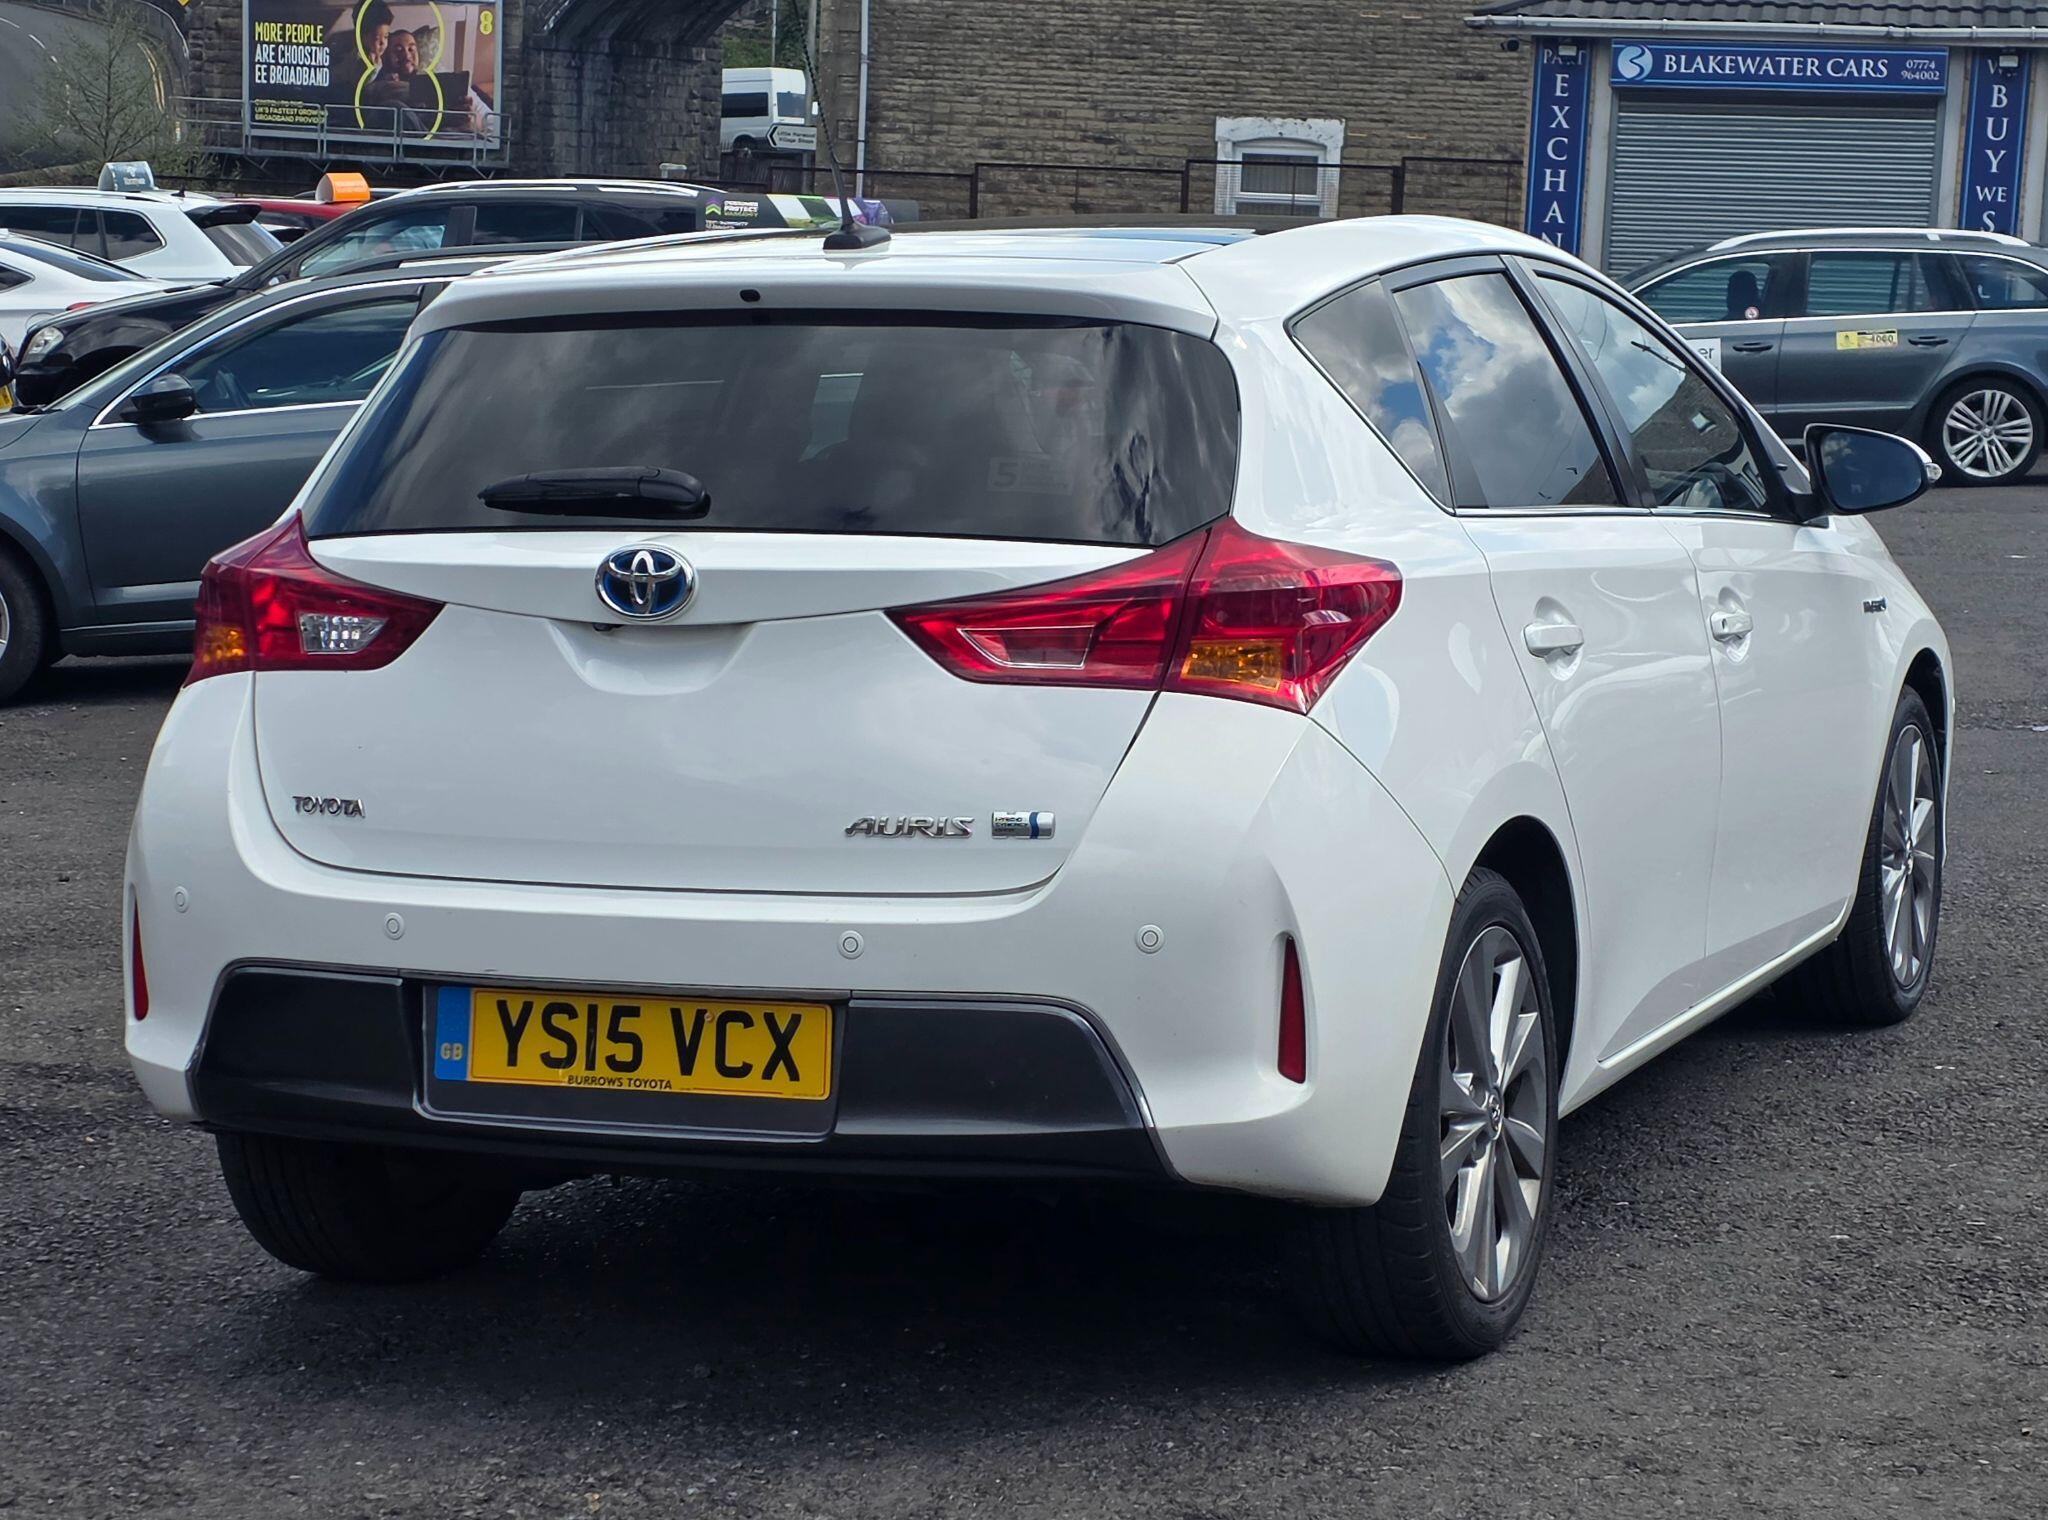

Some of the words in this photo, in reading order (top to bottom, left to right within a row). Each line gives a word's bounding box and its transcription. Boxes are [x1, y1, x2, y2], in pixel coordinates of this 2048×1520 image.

[255, 22, 283, 42] MORE
[285, 24, 323, 44] PEOPLE
[255, 44, 276, 63] ARE
[278, 45, 330, 66] CHOOSING
[1664, 54, 1822, 76] BLAKEWATER
[1826, 58, 1888, 78] CARS
[1905, 59, 1936, 69] 07774
[255, 64, 268, 84] EE
[269, 65, 330, 87] BROADBAND
[1900, 70, 1940, 80] 964002
[1985, 85, 2010, 173] BUY
[1976, 186, 2008, 202] WE
[292, 796, 365, 819] TOYOTA
[844, 815, 976, 838] AURIS
[439, 1041, 464, 1061] GB
[496, 1000, 643, 1073] YS15
[671, 1007, 803, 1082] VCX
[567, 1075, 623, 1089] BURROWS
[627, 1078, 672, 1091] TOYOTA
